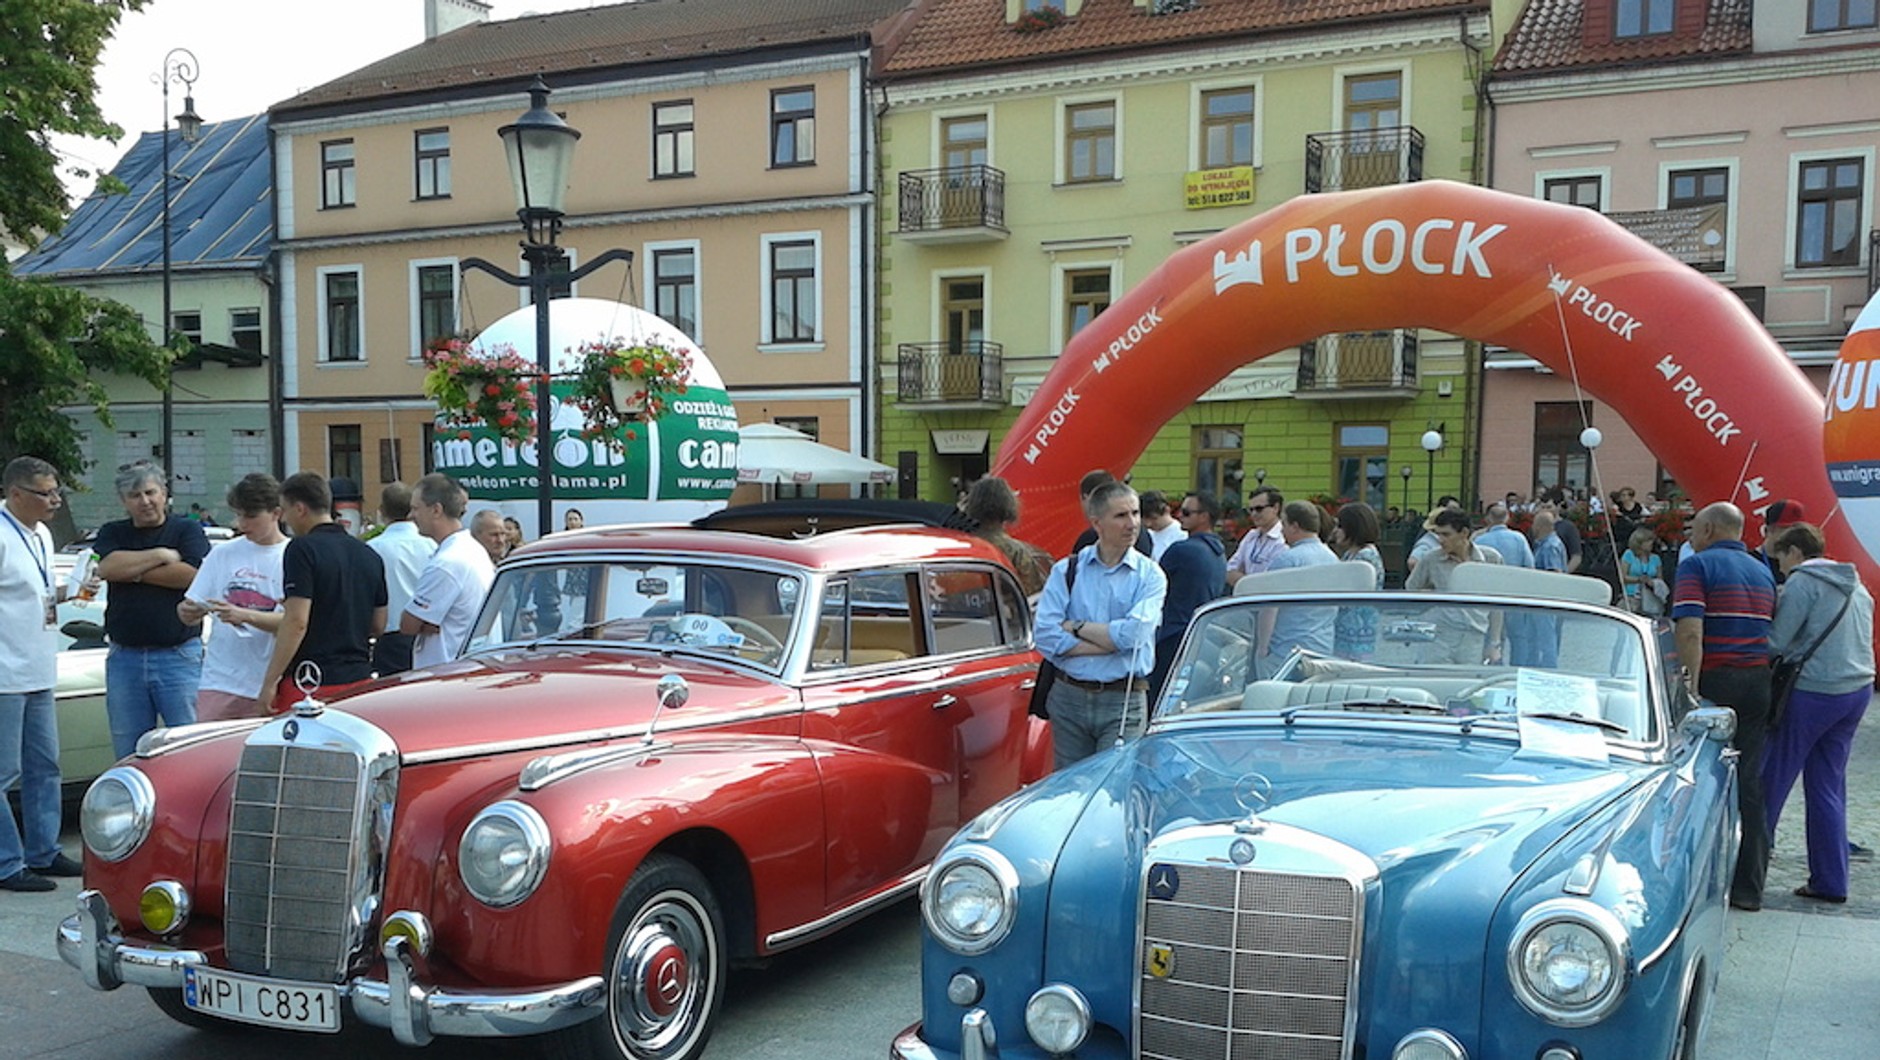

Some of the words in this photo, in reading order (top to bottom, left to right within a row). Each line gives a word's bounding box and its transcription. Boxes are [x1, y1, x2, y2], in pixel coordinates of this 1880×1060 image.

[1285, 219, 1507, 283] PŁOCK
[1109, 307, 1163, 360] PŁOCK
[1569, 286, 1643, 341] PŁOCK
[674, 400, 720, 415] ODZIEŻ
[1035, 387, 1081, 447] PŁOCK
[1673, 375, 1741, 446] PŁOCK
[692, 620, 708, 631] 00
[198, 975, 243, 1013] WPI
[257, 986, 325, 1024] C831
